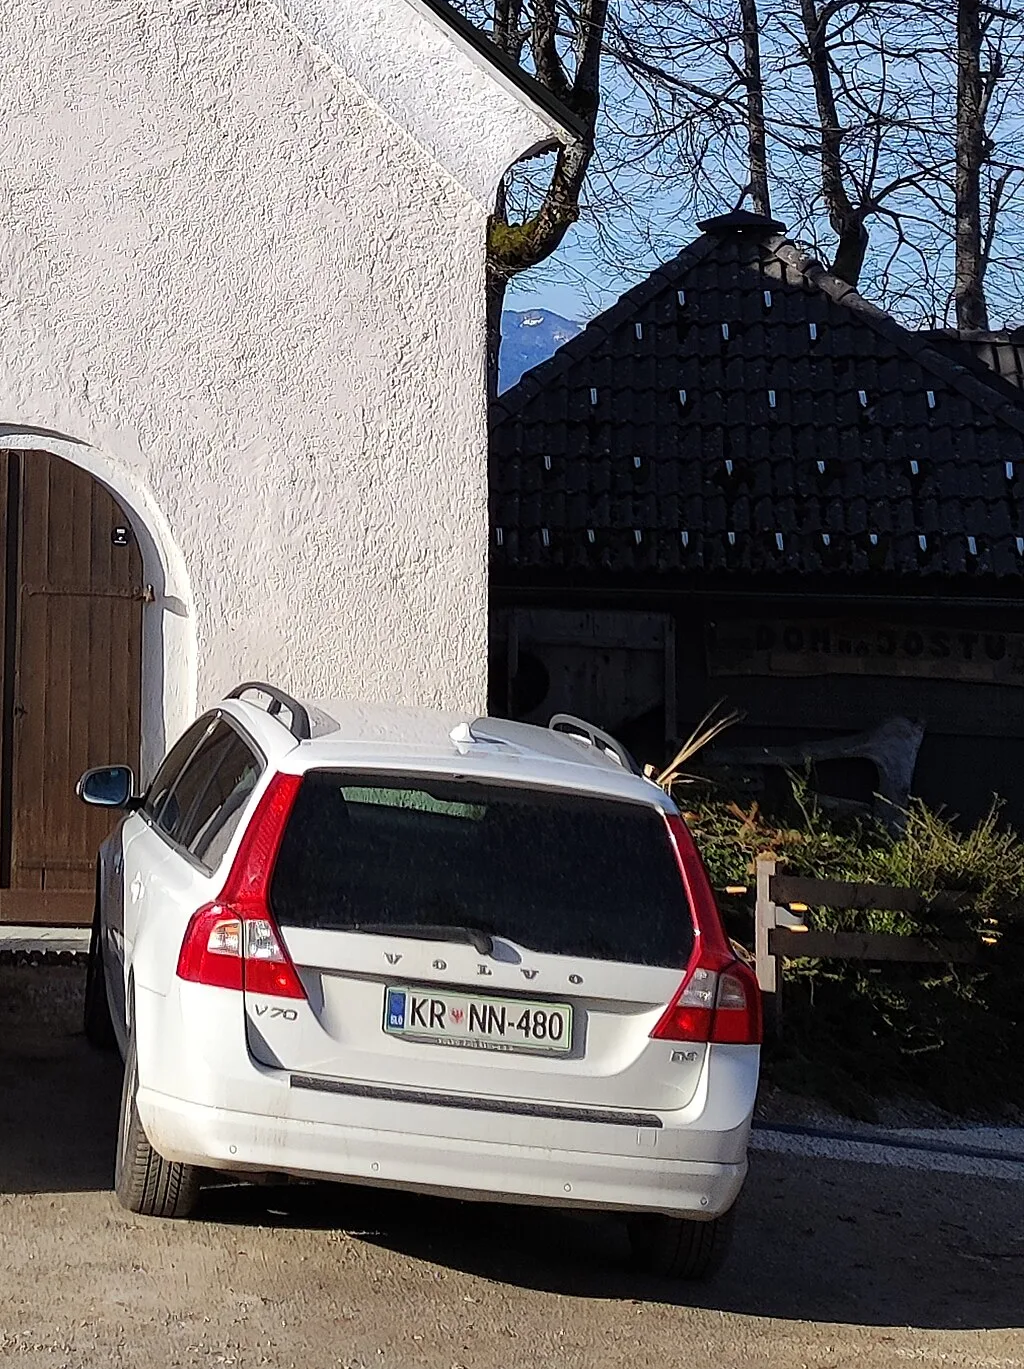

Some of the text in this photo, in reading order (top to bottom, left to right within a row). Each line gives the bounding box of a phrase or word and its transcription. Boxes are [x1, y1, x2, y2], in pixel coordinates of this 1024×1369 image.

[877, 629, 1006, 661] JOSTU
[384, 952, 584, 985] VOLVO
[255, 1004, 298, 1021] V70
[409, 997, 564, 1041] KR NN-480
